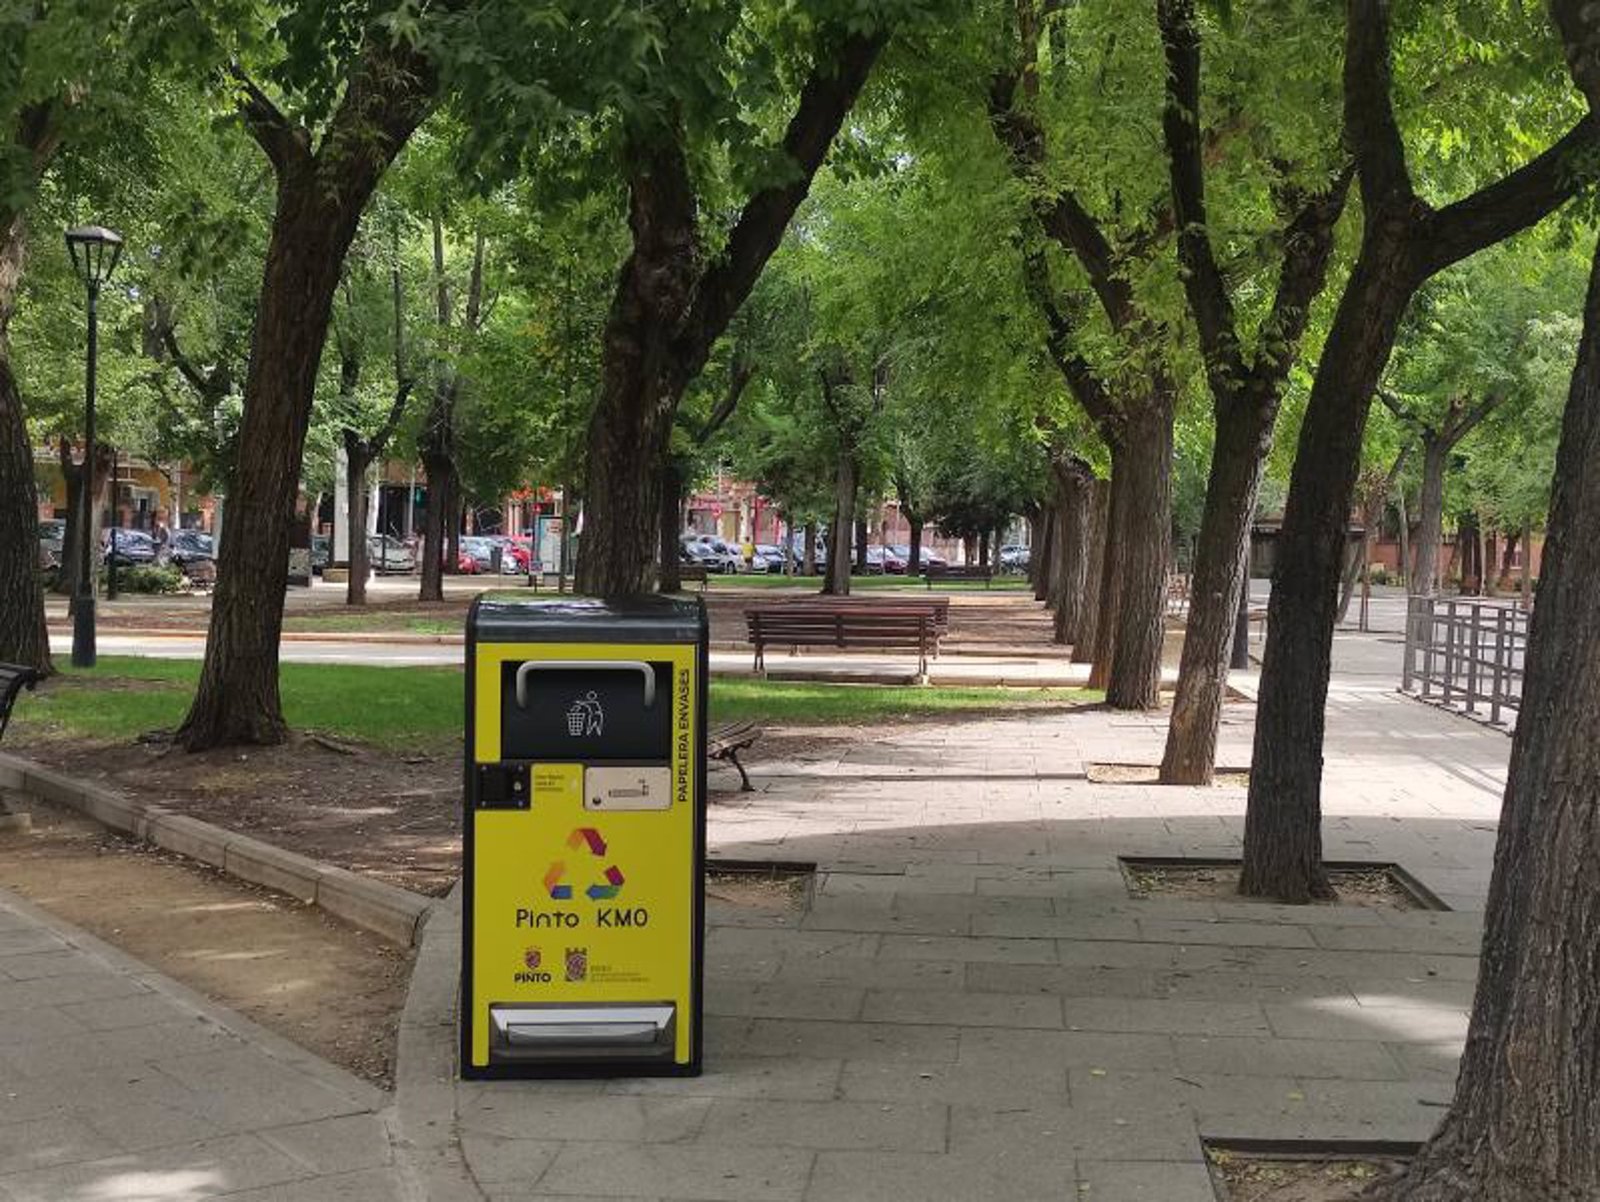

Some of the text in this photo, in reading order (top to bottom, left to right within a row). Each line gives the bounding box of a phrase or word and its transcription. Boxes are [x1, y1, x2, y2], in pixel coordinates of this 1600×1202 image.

[678, 669, 690, 802] PAPELERA ENVASES
[515, 908, 580, 928] Pinto
[514, 972, 552, 983] PINTO
